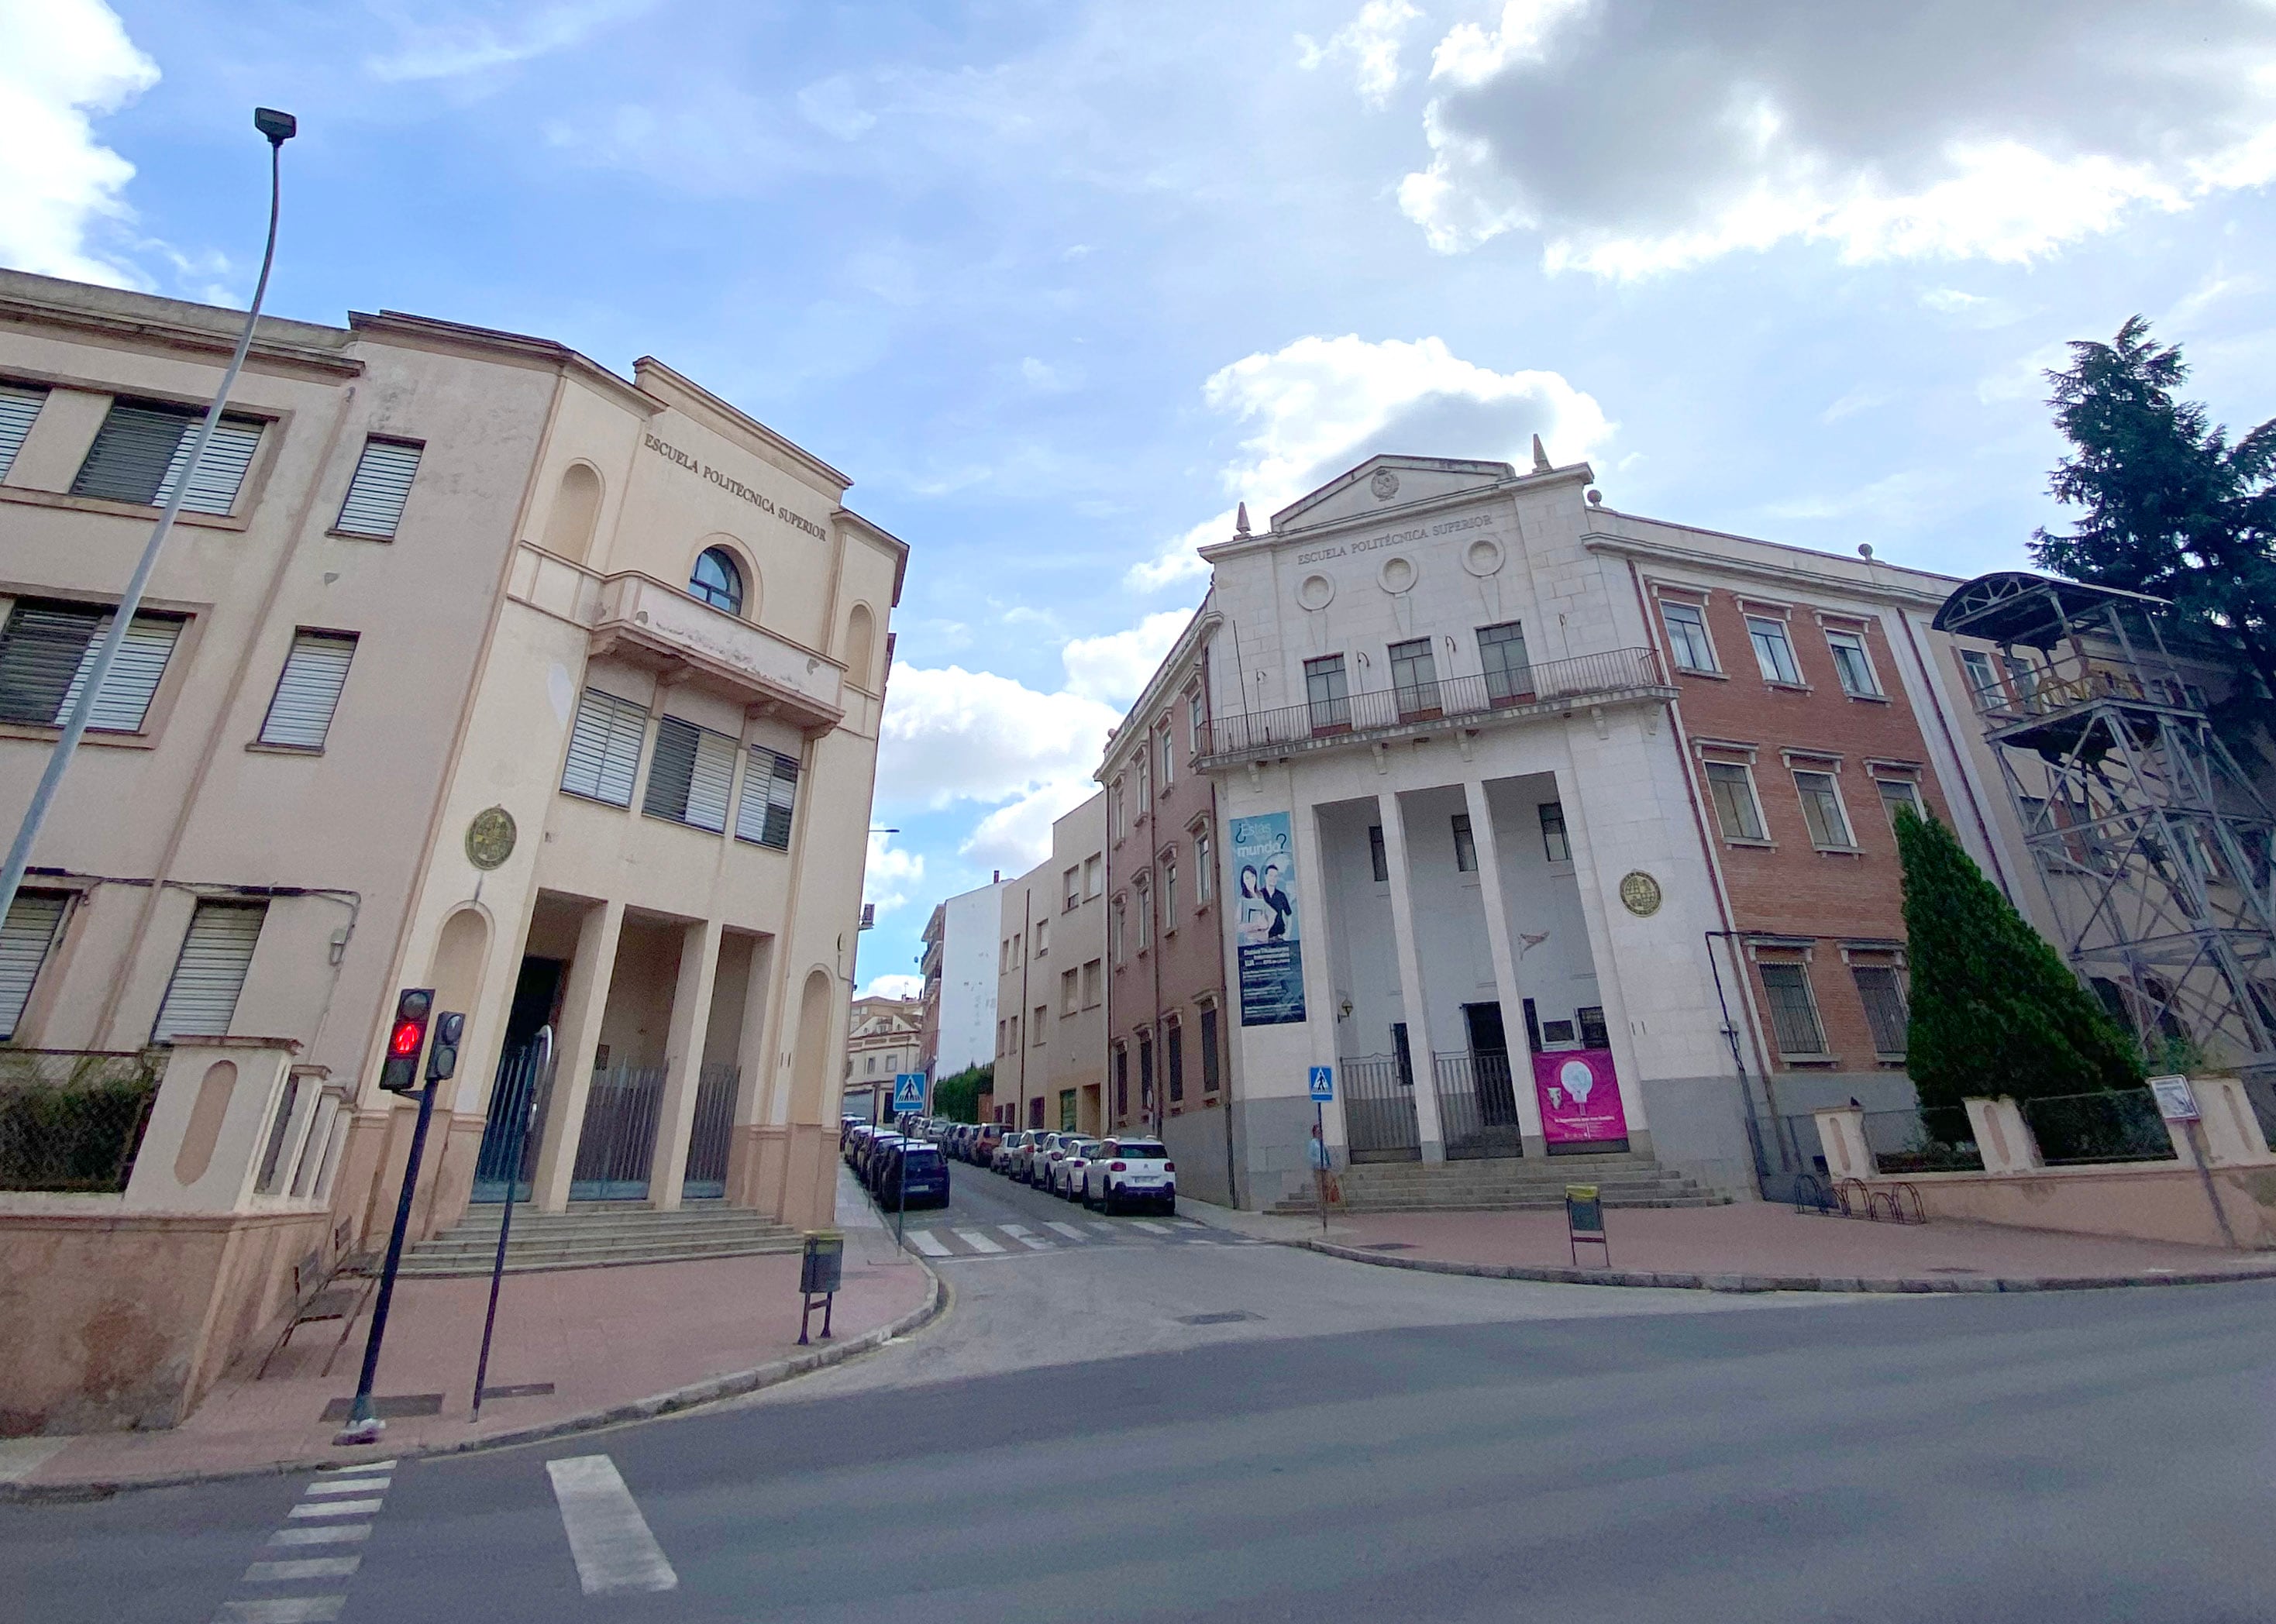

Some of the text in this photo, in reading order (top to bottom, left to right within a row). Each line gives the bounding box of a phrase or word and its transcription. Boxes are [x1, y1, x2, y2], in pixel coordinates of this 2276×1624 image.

[644, 433, 698, 473] ESCUELA
[778, 508, 826, 542] SUPERIOR
[1297, 514, 1493, 565] ESCUELA POLITÉCNICA SUPERIOR
